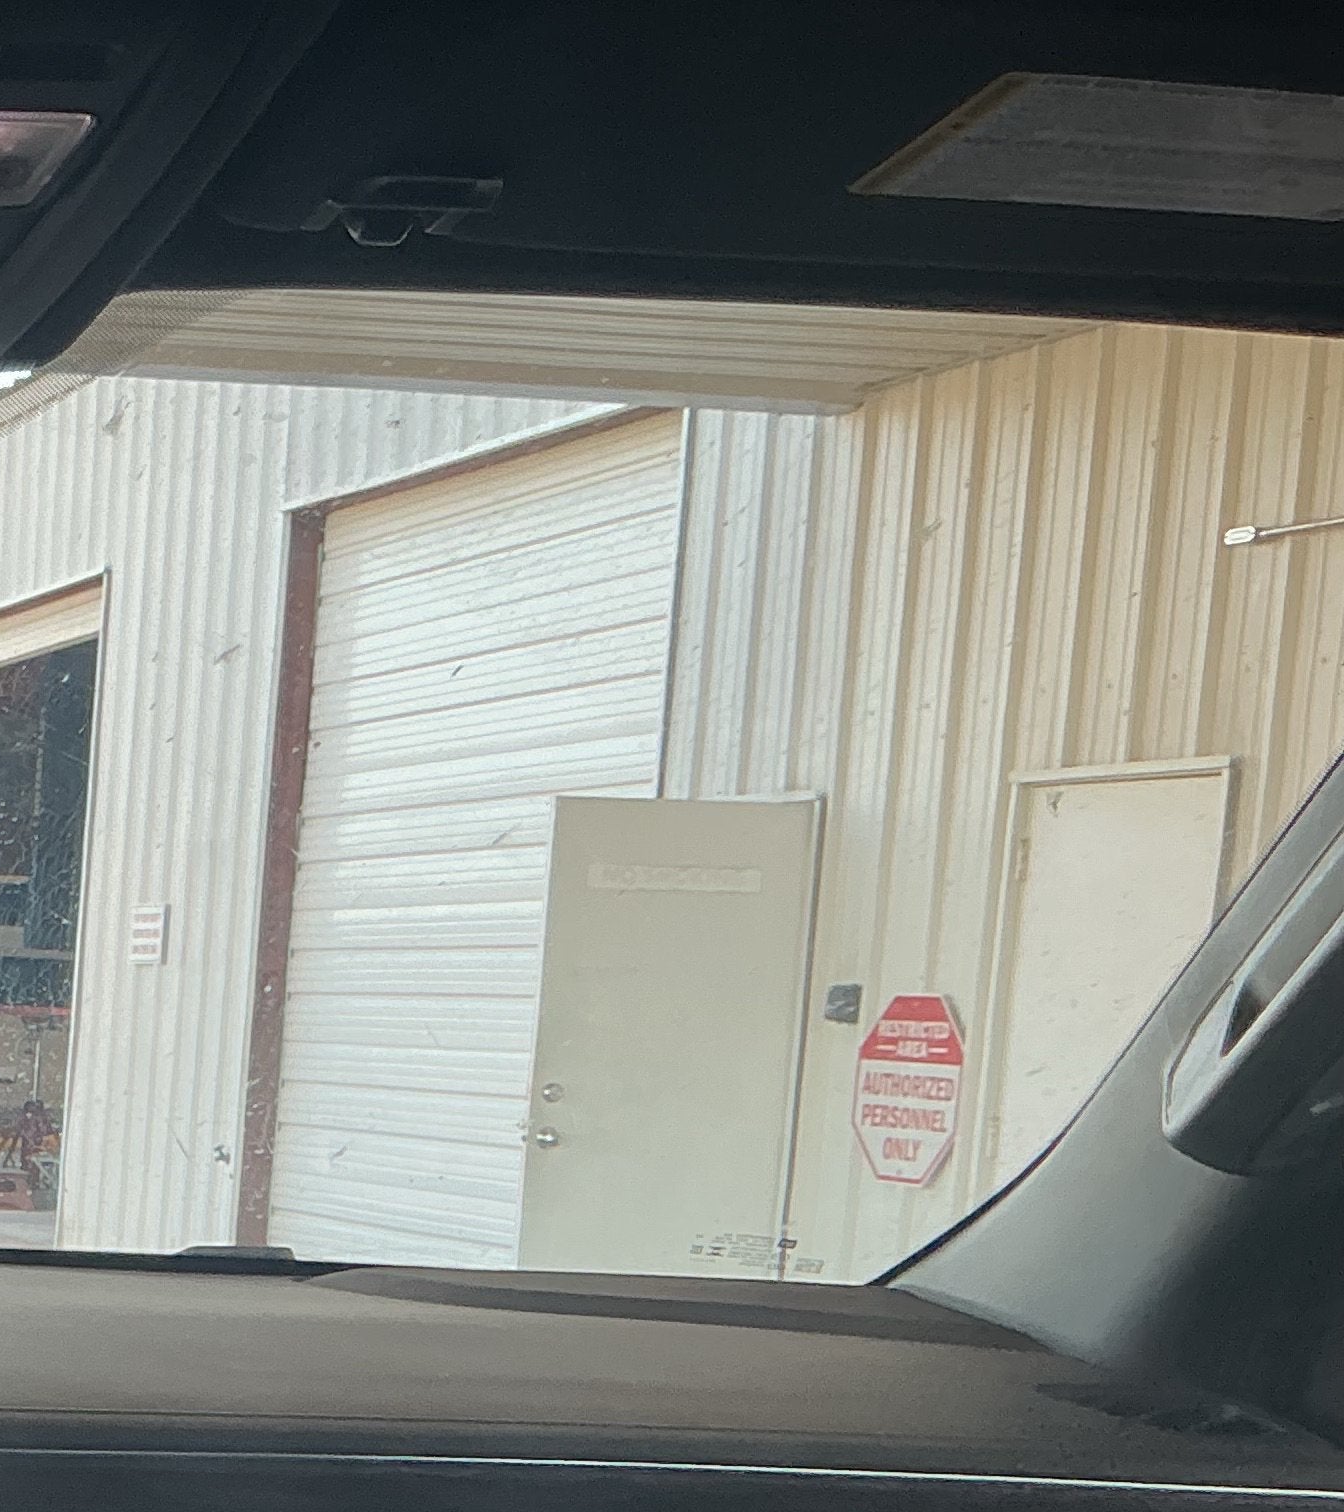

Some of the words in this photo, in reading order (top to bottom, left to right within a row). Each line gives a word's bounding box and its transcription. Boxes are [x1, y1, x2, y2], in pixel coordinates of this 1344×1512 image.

[863, 1071, 955, 1101] AUTHORIZED
[861, 1104, 947, 1132] PERSONNEL
[883, 1137, 923, 1162] ONLY
